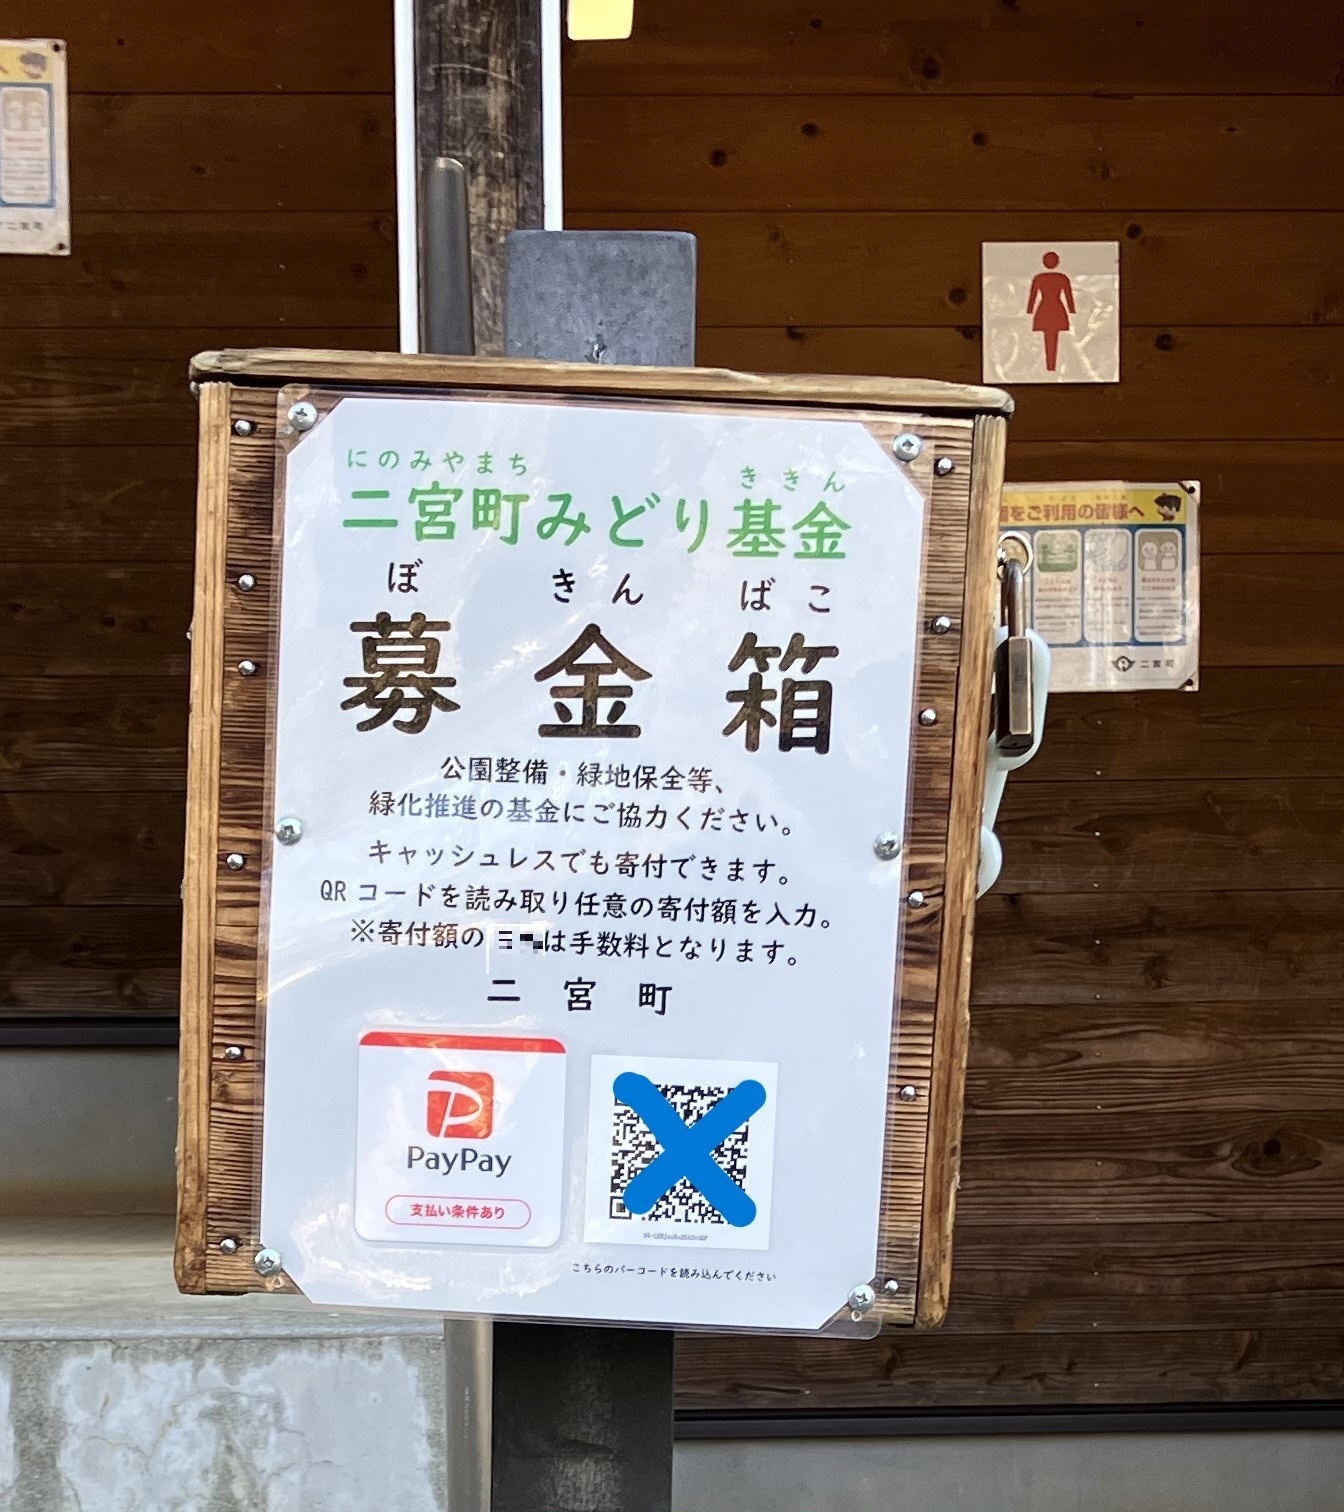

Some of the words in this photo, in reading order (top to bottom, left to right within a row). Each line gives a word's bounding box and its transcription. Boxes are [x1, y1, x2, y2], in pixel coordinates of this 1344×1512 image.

[347, 448, 527, 477] にのみやまち
[740, 465, 845, 493] ききん
[342, 480, 852, 560] 二宮町みどり基金
[340, 611, 840, 755] 募金箱
[441, 756, 726, 795] 公園整備・緑地保全等、
[368, 790, 792, 838] 緑化推進の基金にご協力ください。
[368, 839, 790, 886] キャッシュレスでも寄付できます。
[487, 976, 673, 1016] 二宮町
[407, 1146, 512, 1178] PayPay
[410, 1202, 506, 1220] 支払い条件あり
